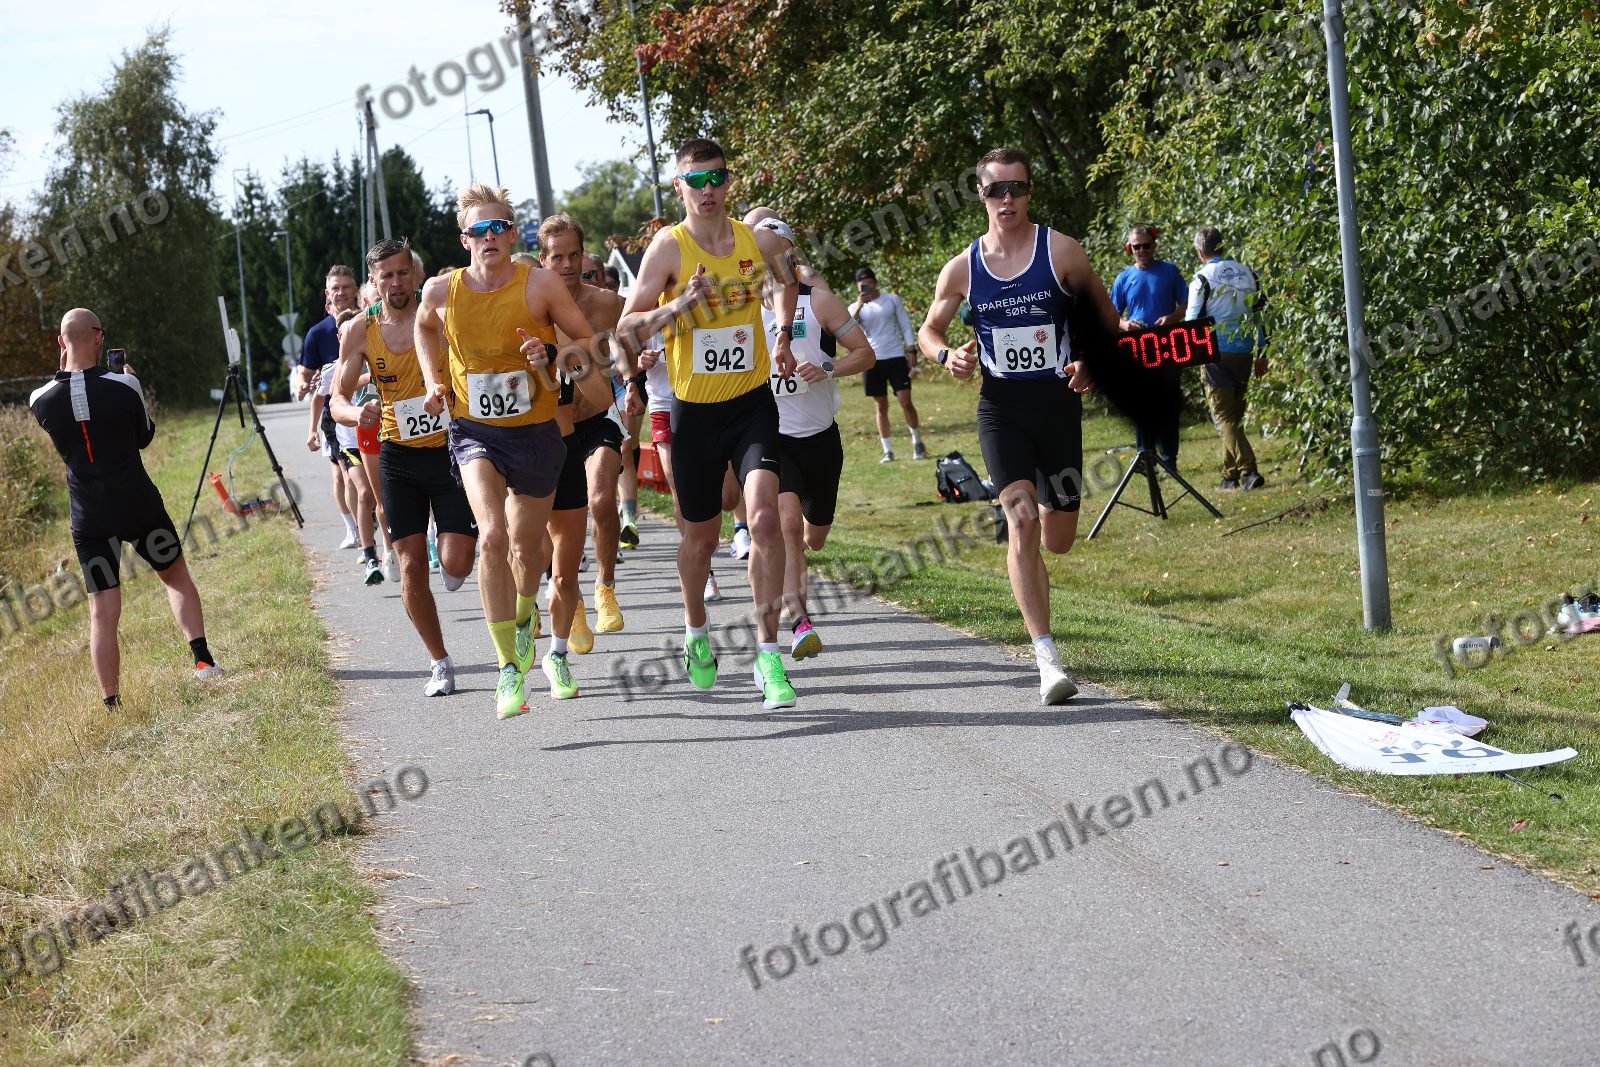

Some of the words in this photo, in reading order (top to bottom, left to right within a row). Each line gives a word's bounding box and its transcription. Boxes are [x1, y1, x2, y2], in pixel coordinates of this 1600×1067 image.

[977, 290, 1052, 313] SPAREBANKEN
[1005, 306, 1027, 317] SØR
[704, 346, 746, 372] 942
[1005, 347, 1046, 370] 993
[479, 392, 519, 417] 992
[406, 414, 443, 437] 252
